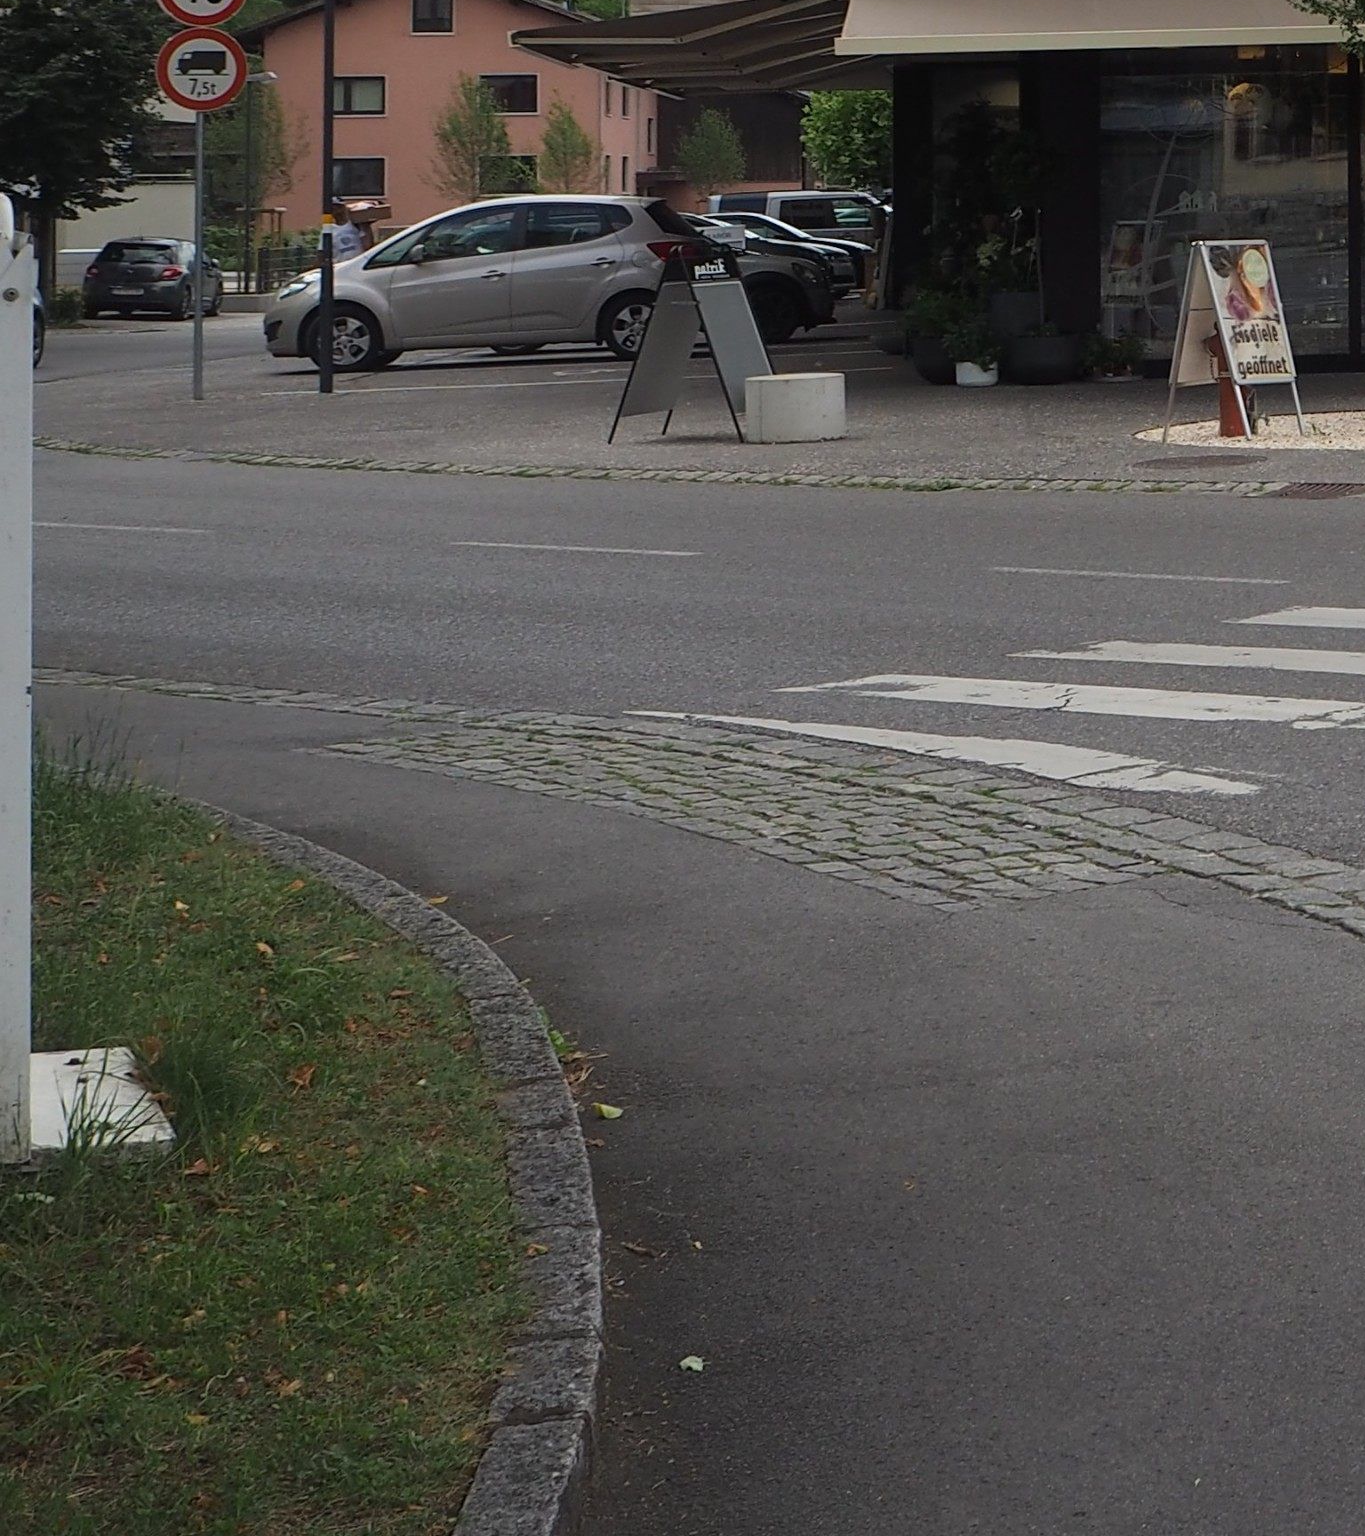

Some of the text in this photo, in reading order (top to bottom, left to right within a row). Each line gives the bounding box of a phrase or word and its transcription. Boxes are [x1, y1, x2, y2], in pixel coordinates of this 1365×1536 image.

[188, 78, 217, 98] 7,5t
[1230, 322, 1279, 345] Eisdiele
[1238, 355, 1290, 379] geöffnet
